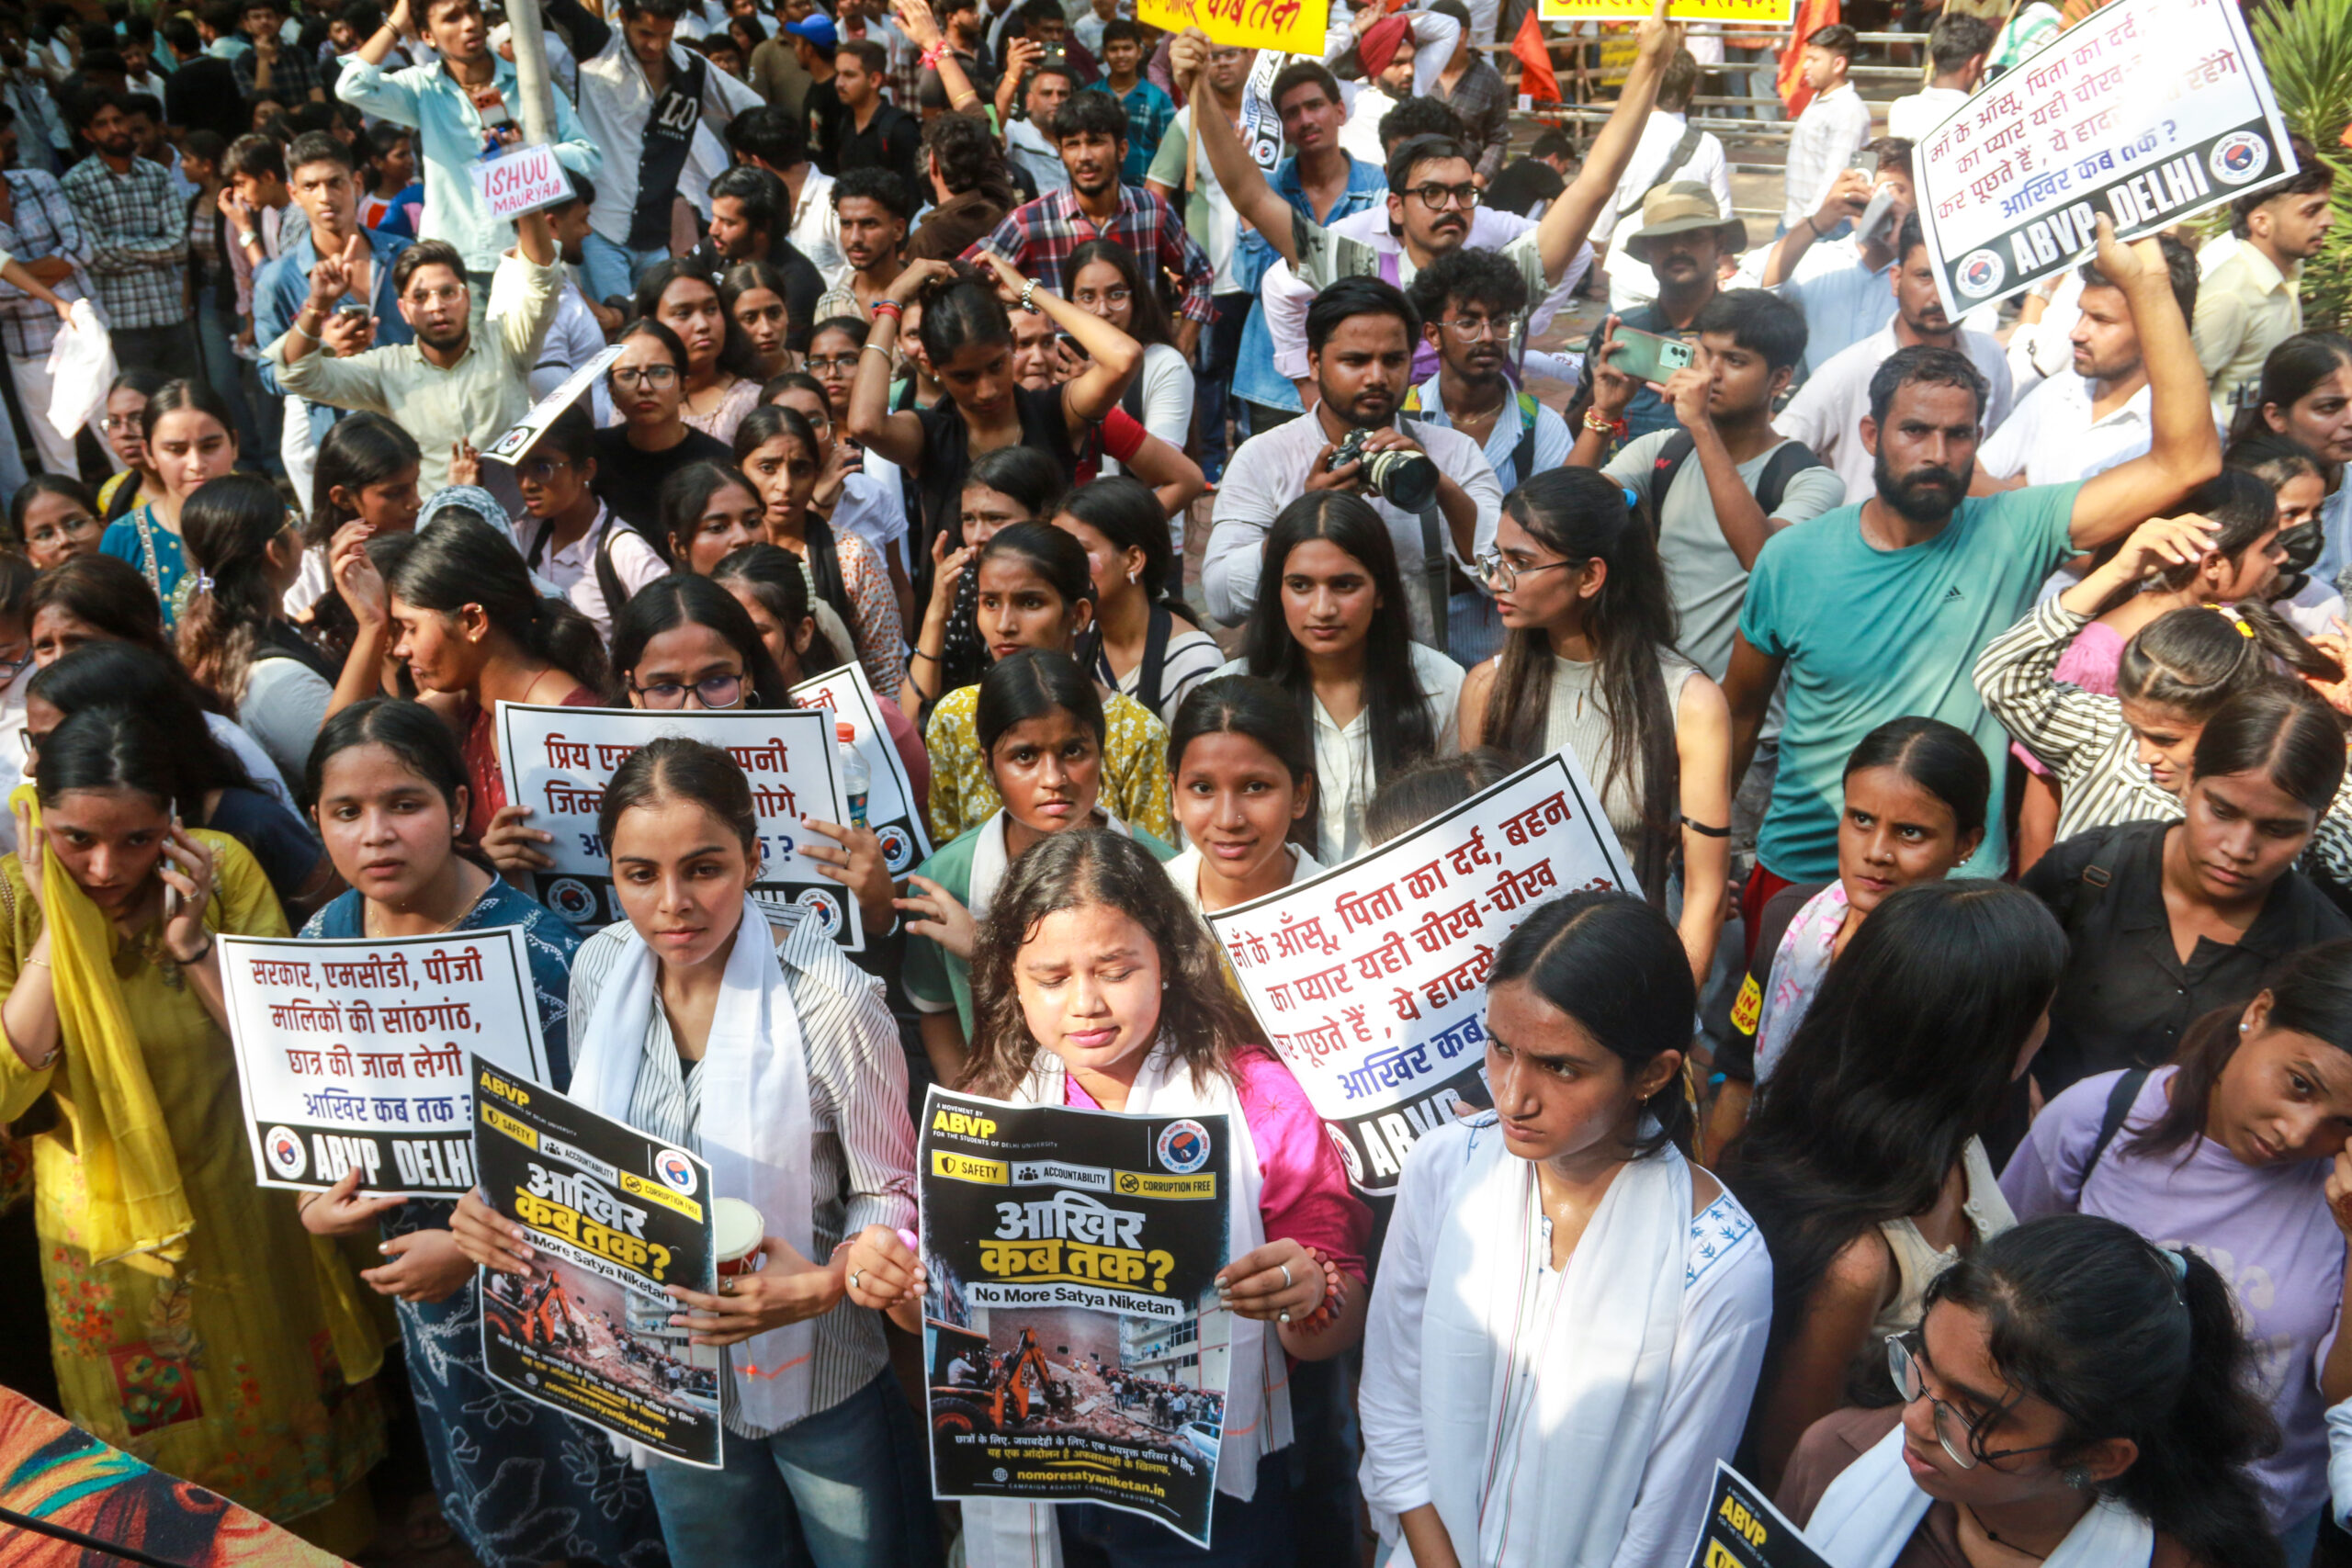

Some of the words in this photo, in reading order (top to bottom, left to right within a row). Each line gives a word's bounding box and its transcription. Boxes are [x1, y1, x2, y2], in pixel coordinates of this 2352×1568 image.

[1953, 121, 1971, 144] के
[2026, 58, 2068, 96] पिता
[2072, 39, 2101, 65] का
[1956, 148, 1981, 174] का
[1984, 119, 2026, 154] प्यार
[2030, 90, 2069, 127] यही
[485, 153, 548, 198] ISHUU
[1937, 190, 1966, 220] कर
[1970, 159, 2014, 204] पूछते
[2049, 130, 2069, 152] ये
[2000, 172, 2072, 219] आखिर
[2074, 148, 2115, 180] कब
[2120, 128, 2158, 162] तक
[2009, 200, 2098, 276] ABVP
[2106, 151, 2211, 230] DELHI
[544, 732, 591, 773] प्रिय
[726, 737, 789, 773] पनी
[1227, 928, 1252, 969] माँ
[1245, 931, 1270, 965] के
[1271, 911, 1341, 958] आँसू,
[1334, 892, 1404, 935] पिता
[1401, 859, 1449, 899] का
[1445, 826, 1503, 875] दर्द,
[1498, 790, 1573, 847] बहन
[1265, 983, 1296, 1012] का
[1293, 963, 1353, 1001] प्यार
[1352, 931, 1412, 979] यही
[1411, 858, 1558, 954] चीख-चीख
[249, 959, 320, 993] सरकार,
[321, 952, 419, 992] एमसीडी,
[422, 946, 485, 985] पीजी
[269, 998, 344, 1033] मालिकों
[345, 999, 376, 1033] की
[379, 997, 481, 1034] सांठगांठ,
[1294, 1015, 1348, 1068] पूछते
[1389, 987, 1422, 1021] ये
[286, 1048, 323, 1077] छात्र
[325, 1043, 355, 1077] की
[356, 1053, 406, 1078] जान
[410, 1042, 463, 1078] लेगी
[1337, 1045, 1433, 1101] आखिर
[1430, 1013, 1485, 1059] कब
[303, 1087, 367, 1122] आखिर
[370, 1097, 409, 1123] कब
[413, 1095, 454, 1123] तक
[480, 1071, 530, 1107] ABVP
[942, 1104, 974, 1115] MOVEMENT
[503, 1118, 530, 1141] SAFETY
[932, 1110, 997, 1138] ABVP
[959, 1134, 989, 1145] STUDENTS
[311, 1134, 380, 1186] ABVP
[391, 1138, 476, 1188] DELH
[564, 1148, 615, 1179] ACCOUNTABILITY
[961, 1162, 999, 1179] SAFETY
[1044, 1167, 1106, 1185] ACCOUNTABILITY
[526, 1162, 648, 1240] आखिर
[645, 1185, 684, 1208] CORRUPTION
[685, 1201, 698, 1216] FREE
[1143, 1180, 1192, 1193] CORRUPTION
[1193, 1181, 1211, 1192] FREE
[514, 1185, 581, 1239] कब
[582, 1215, 672, 1281] तक?
[994, 1190, 1146, 1250] आखिर
[534, 1235, 571, 1257] More
[573, 1249, 615, 1281] Satya
[617, 1266, 671, 1303] Niketan
[979, 1239, 1063, 1277] कब
[1066, 1240, 1175, 1292] तक?
[975, 1287, 1001, 1303] No
[1004, 1288, 1051, 1303] More
[1054, 1289, 1105, 1308] Satya
[1108, 1293, 1175, 1316] Niketan
[978, 1433, 987, 1444] के
[1055, 1435, 1065, 1445] के
[1091, 1440, 1106, 1451] एक
[1170, 1452, 1179, 1464] के
[1016, 1470, 1166, 1498] nomoresatyaniketan.in
[1719, 1495, 1768, 1548] ABVP
